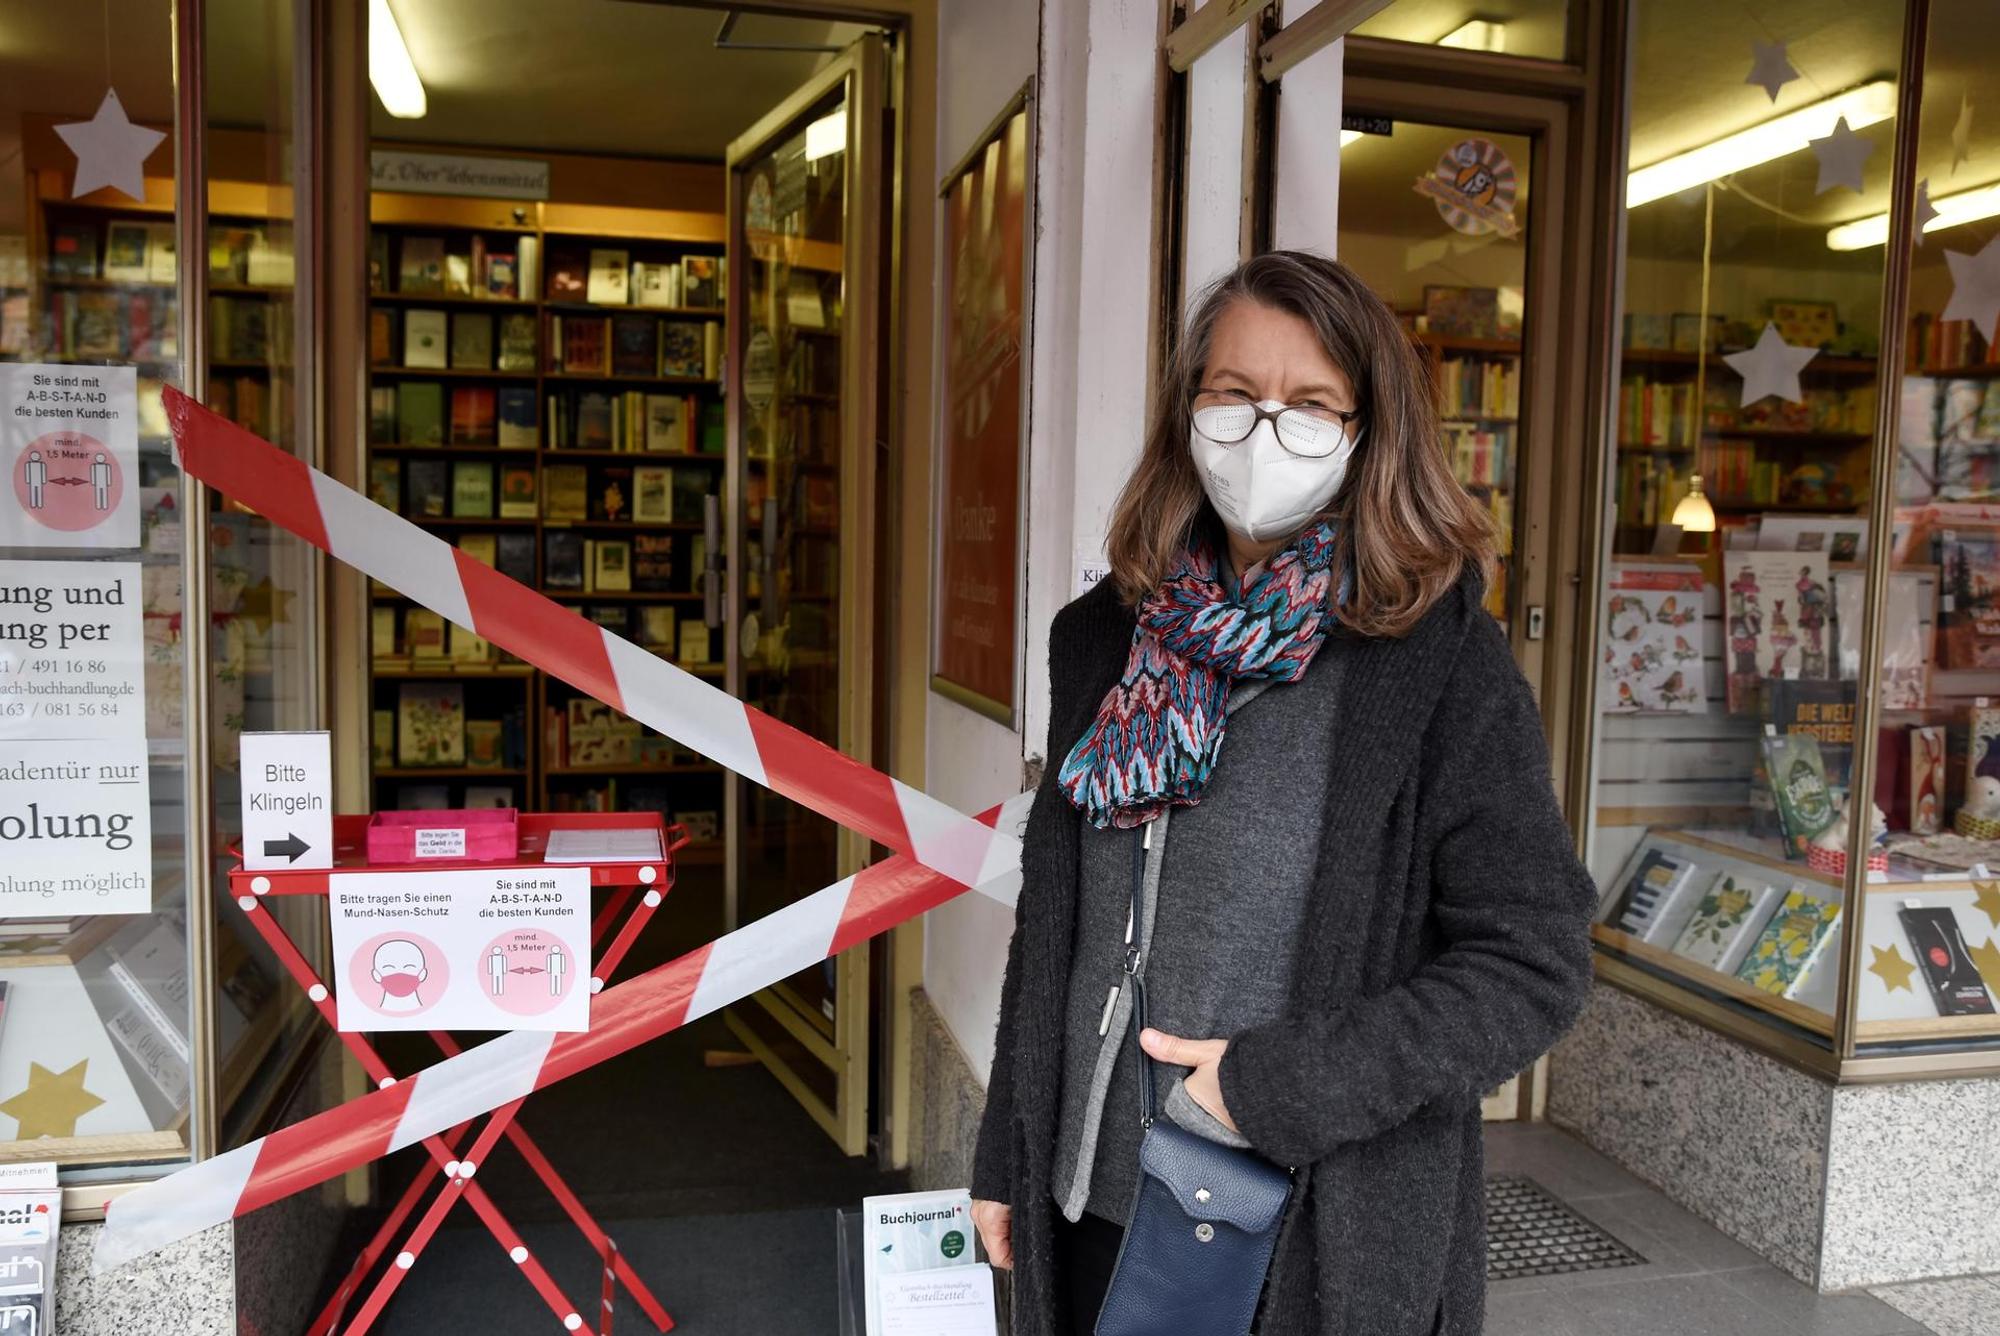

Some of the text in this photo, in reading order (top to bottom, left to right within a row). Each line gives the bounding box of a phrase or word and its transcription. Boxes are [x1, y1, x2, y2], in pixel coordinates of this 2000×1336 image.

[33, 375, 100, 388] Sie sind mit
[27, 391, 107, 403] A-B-S-T-A-N-D
[15, 406, 119, 420] die besten Kunden
[62, 451, 90, 460] Meter
[64, 579, 125, 605] und
[58, 622, 111, 650] per
[32, 660, 58, 673] 491
[66, 660, 83, 673] 16
[88, 660, 106, 673] 86
[45, 702, 71, 716] 081
[78, 703, 96, 716] 56
[100, 703, 119, 716] 84
[0, 760, 140, 781] adentür nur
[265, 764, 307, 783] Bitte
[250, 792, 323, 815] Klingeln
[0, 803, 134, 851] olung
[62, 872, 146, 897] möglich
[496, 880, 556, 890] Sie sind mit
[340, 893, 452, 907] Bitte tragen Sie einen
[489, 893, 563, 904] A-B-S-T-A-N-D
[344, 906, 450, 918] Mund-Nasen-Schutz
[479, 907, 574, 918] die besten Kunden
[507, 944, 518, 952] 1,5
[880, 1206, 956, 1225] Buchjournal
